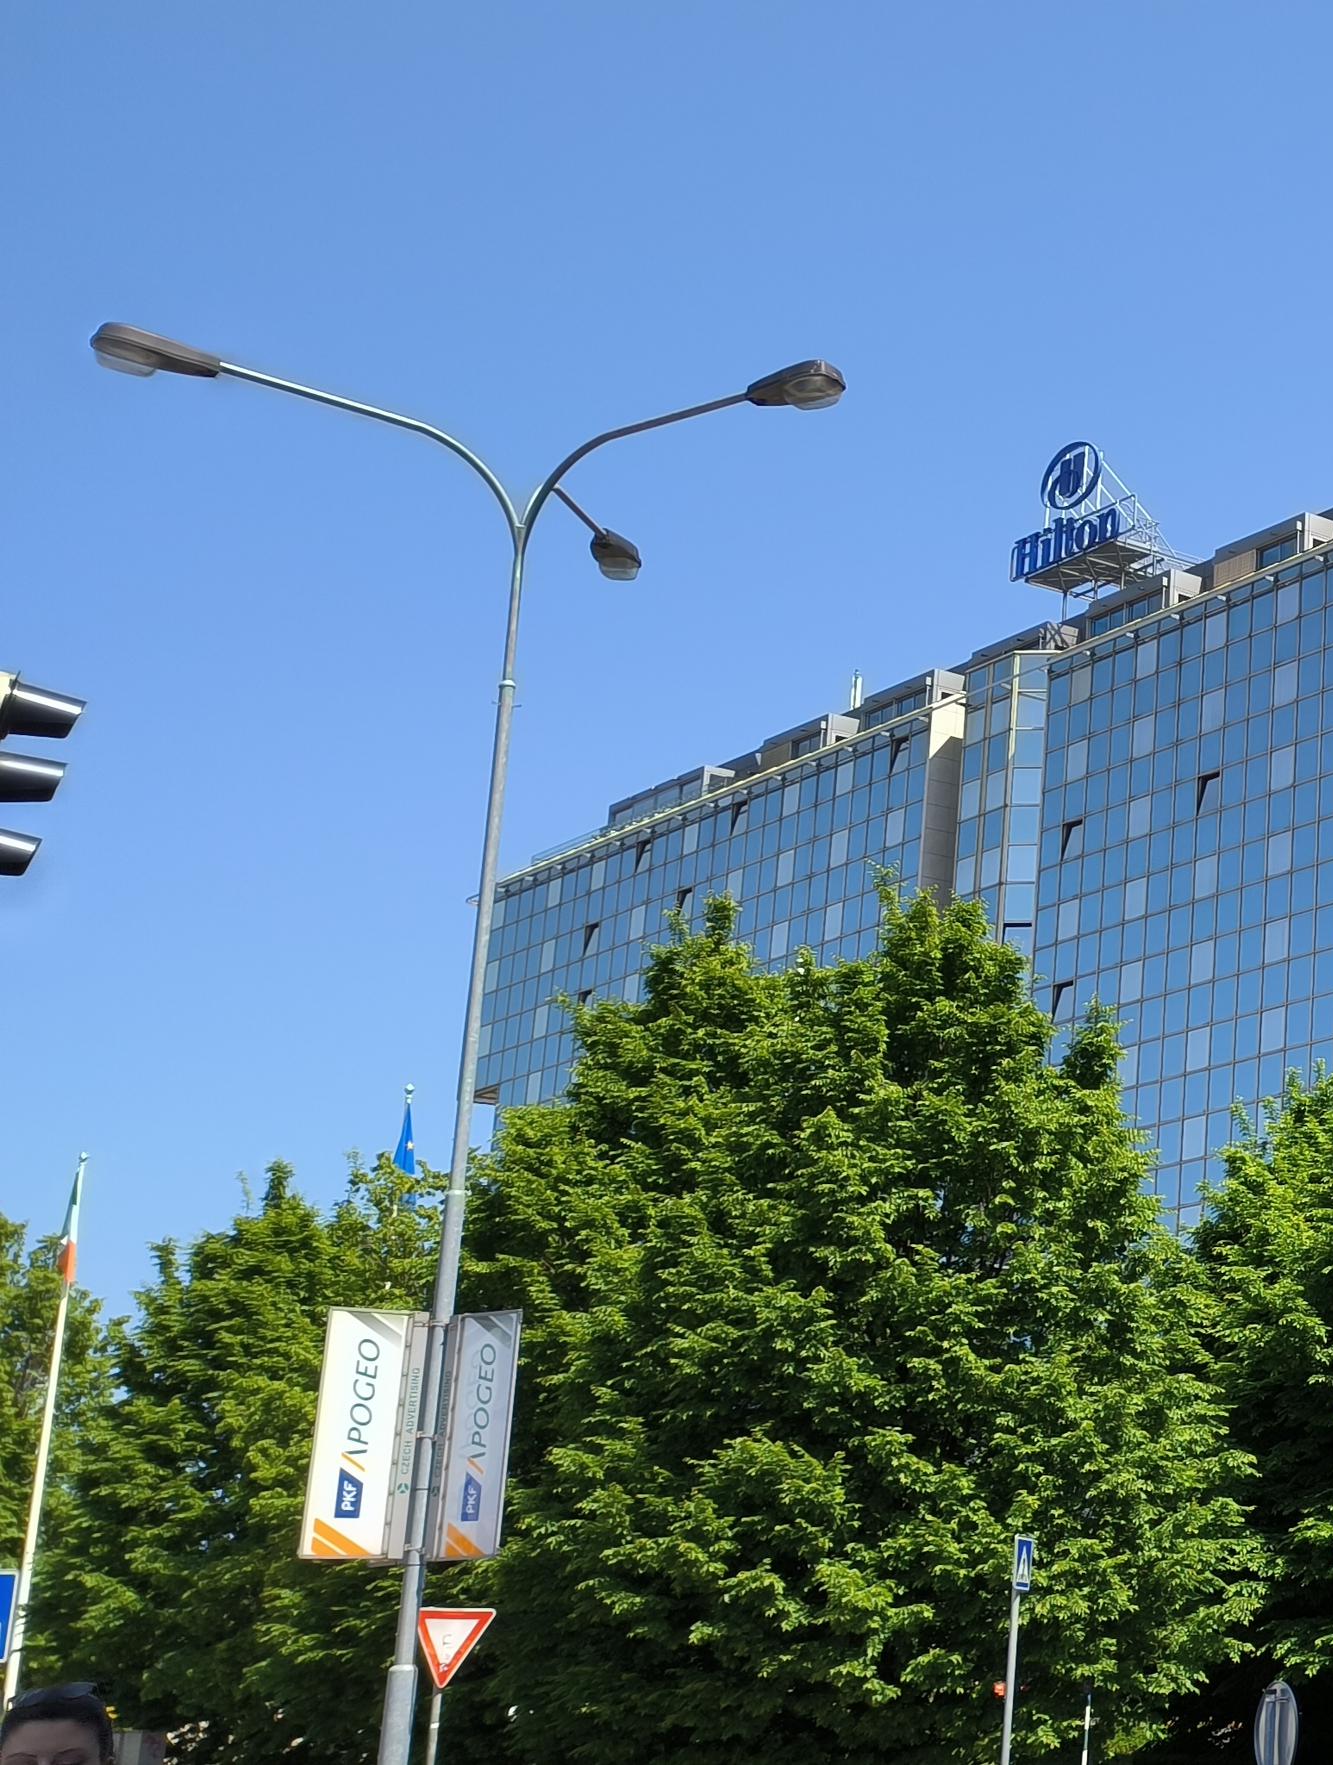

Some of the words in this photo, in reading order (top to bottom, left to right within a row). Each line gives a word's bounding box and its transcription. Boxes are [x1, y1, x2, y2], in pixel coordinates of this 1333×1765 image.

[1014, 507, 1120, 577] Hilton
[341, 1338, 380, 1472] APOGEO
[401, 1440, 412, 1474] CZECH
[407, 1367, 420, 1434] ADVERTISING
[467, 1343, 496, 1475] APOGEO
[341, 1483, 357, 1511] PKF
[466, 1487, 479, 1513] PKF
